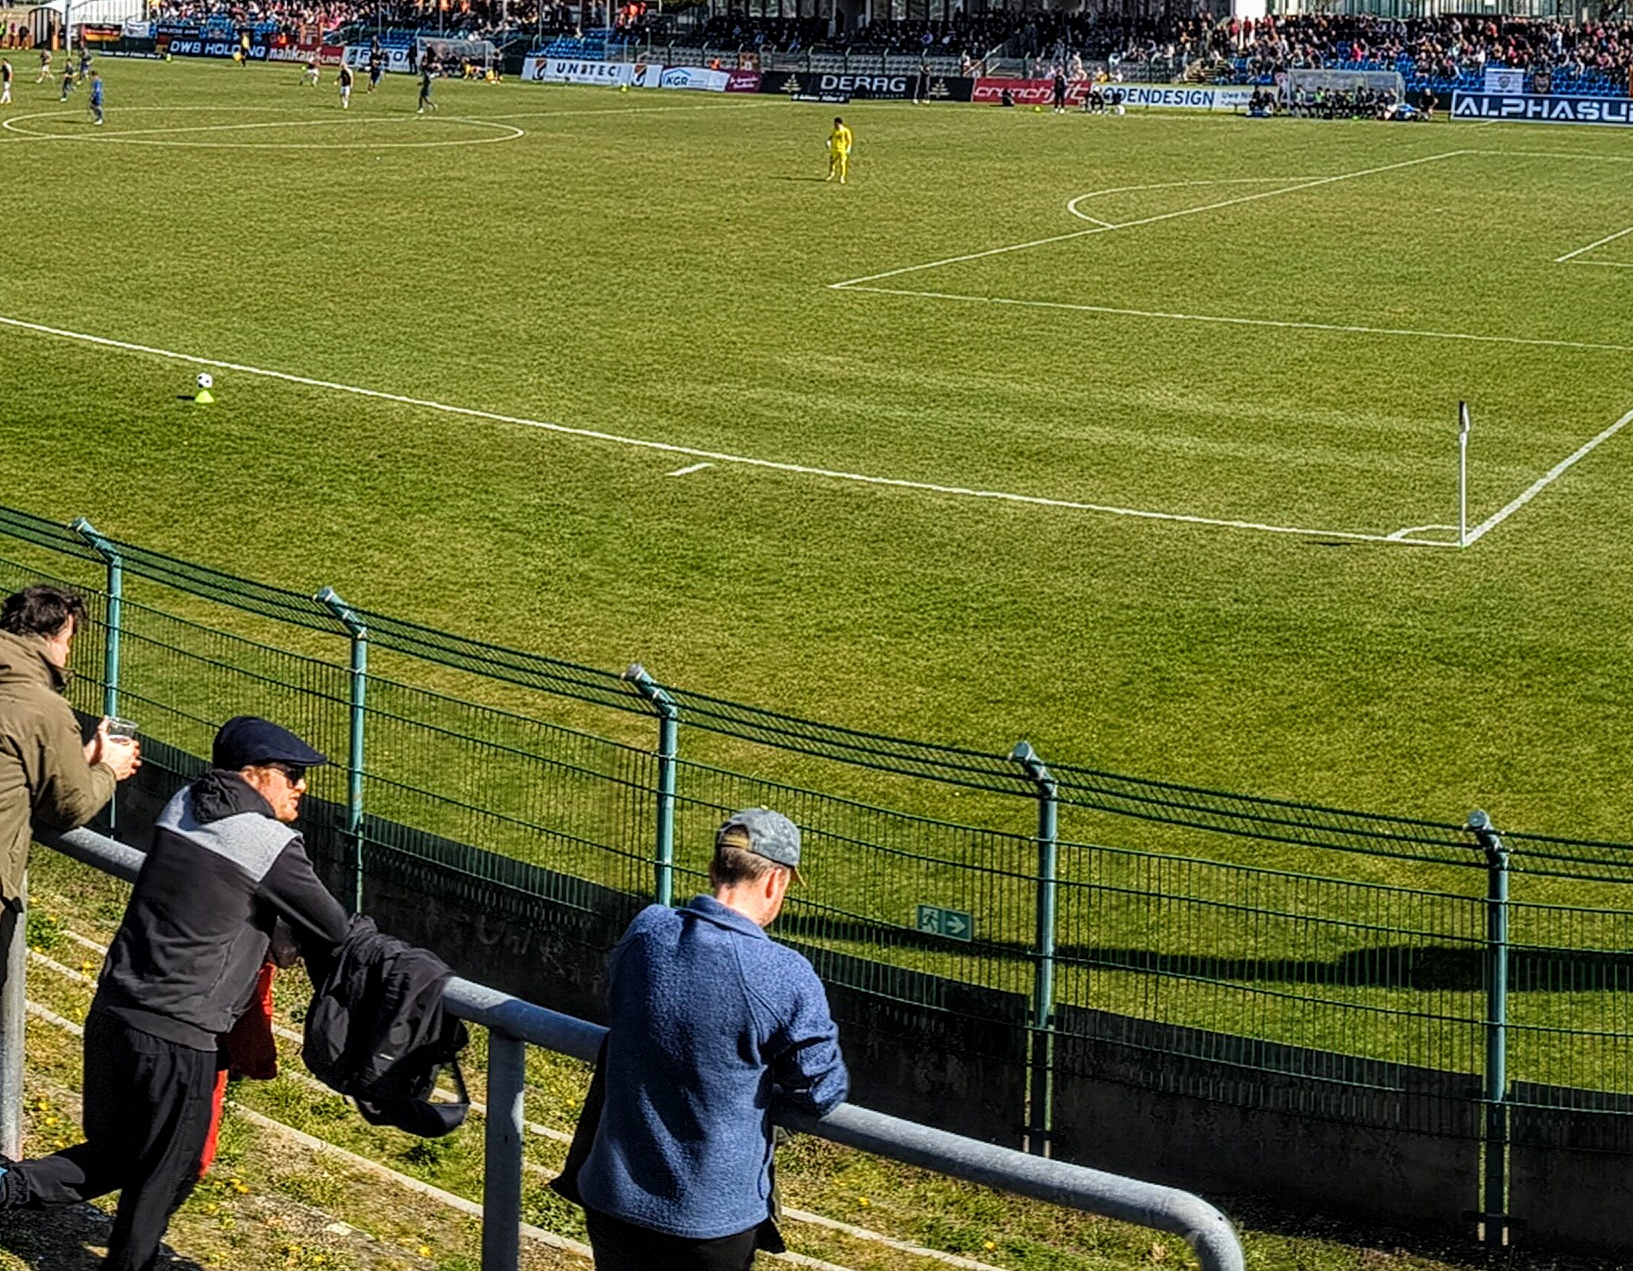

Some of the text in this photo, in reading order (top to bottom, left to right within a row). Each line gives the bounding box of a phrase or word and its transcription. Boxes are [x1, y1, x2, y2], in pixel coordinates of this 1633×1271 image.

[170, 41, 266, 58] DWB HOLDNG
[820, 75, 907, 92] DERAG
[1103, 86, 1215, 105] ODENDESIGN
